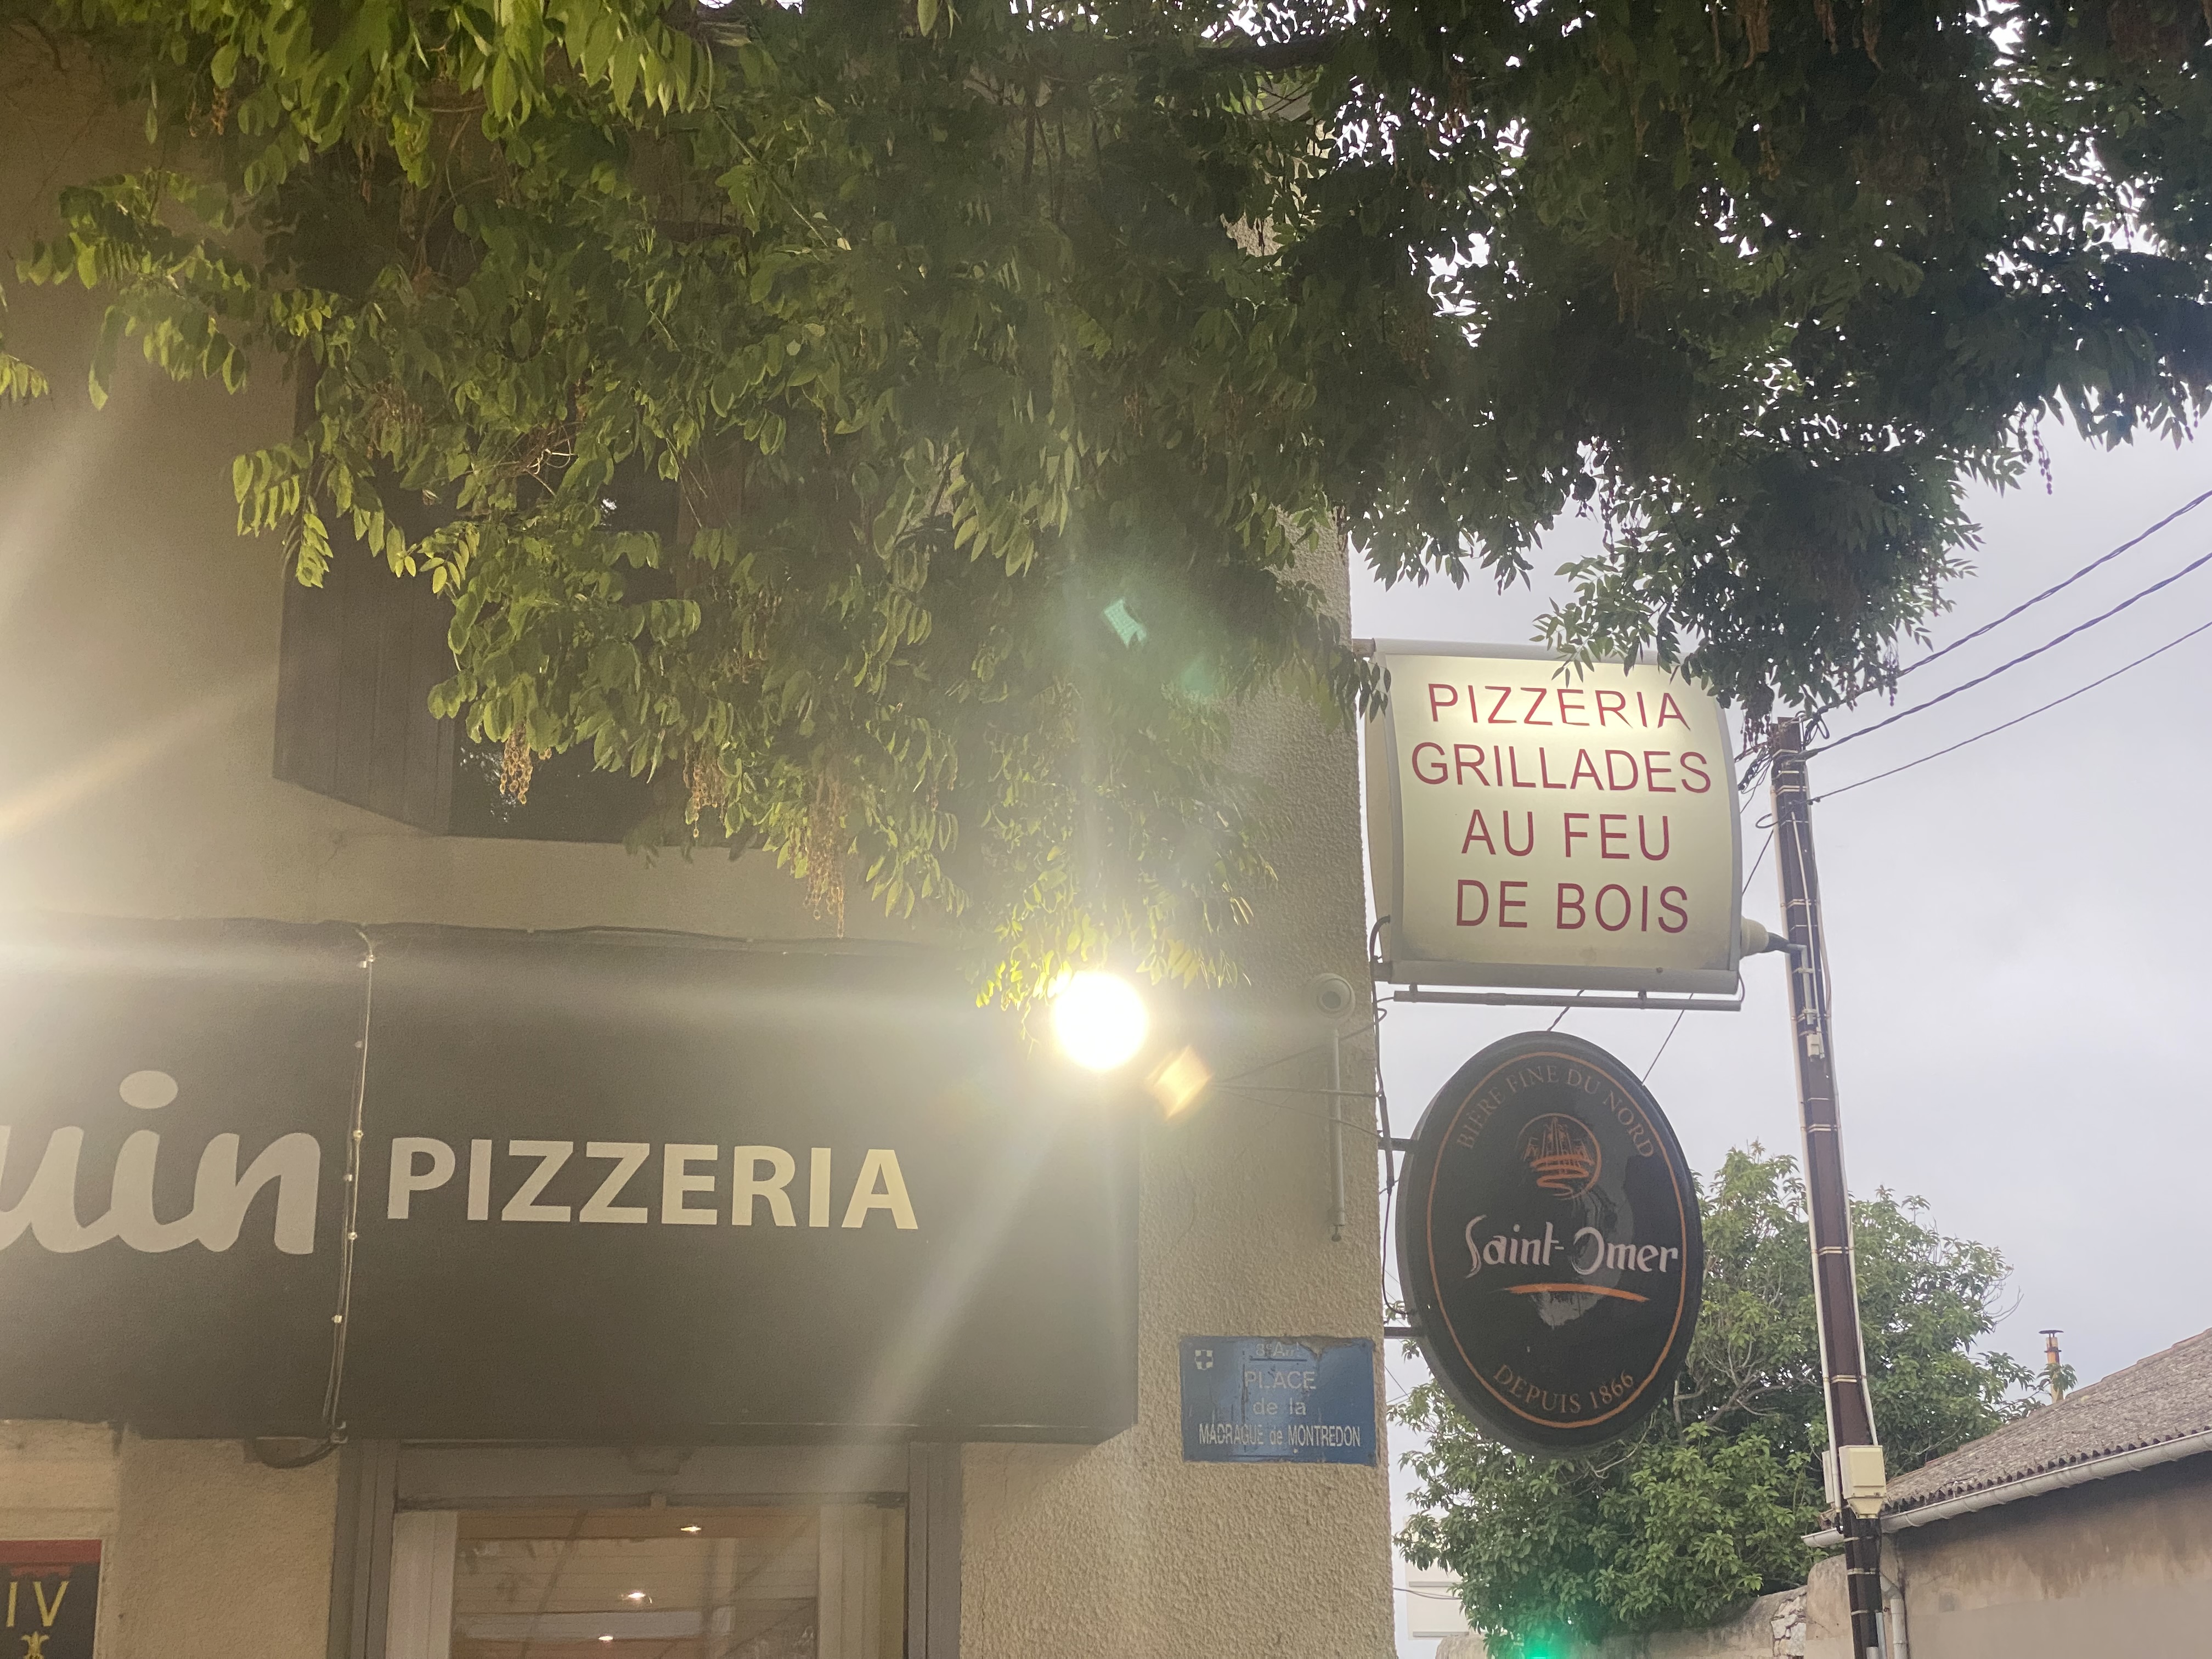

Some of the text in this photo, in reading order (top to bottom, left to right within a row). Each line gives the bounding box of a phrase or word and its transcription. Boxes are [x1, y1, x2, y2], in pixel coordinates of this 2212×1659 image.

[1428, 684, 1691, 731] PIZZERIA
[1412, 742, 1711, 793] GRILLADES
[1462, 809, 1669, 861] AU FEU
[1456, 879, 1688, 933] DE BOIS
[1506, 1065, 1559, 1094] FINE
[1567, 1069, 1601, 1094] DU
[1602, 1090, 1655, 1157] NORD
[387, 1137, 918, 1229] PIZZERIA
[1244, 1371, 1316, 1390] PLACE
[1493, 1364, 1633, 1414] DEPUIS 1866
[1252, 1398, 1307, 1415] de la
[1199, 1424, 1361, 1447] MADRAGUE de MONTREDON
